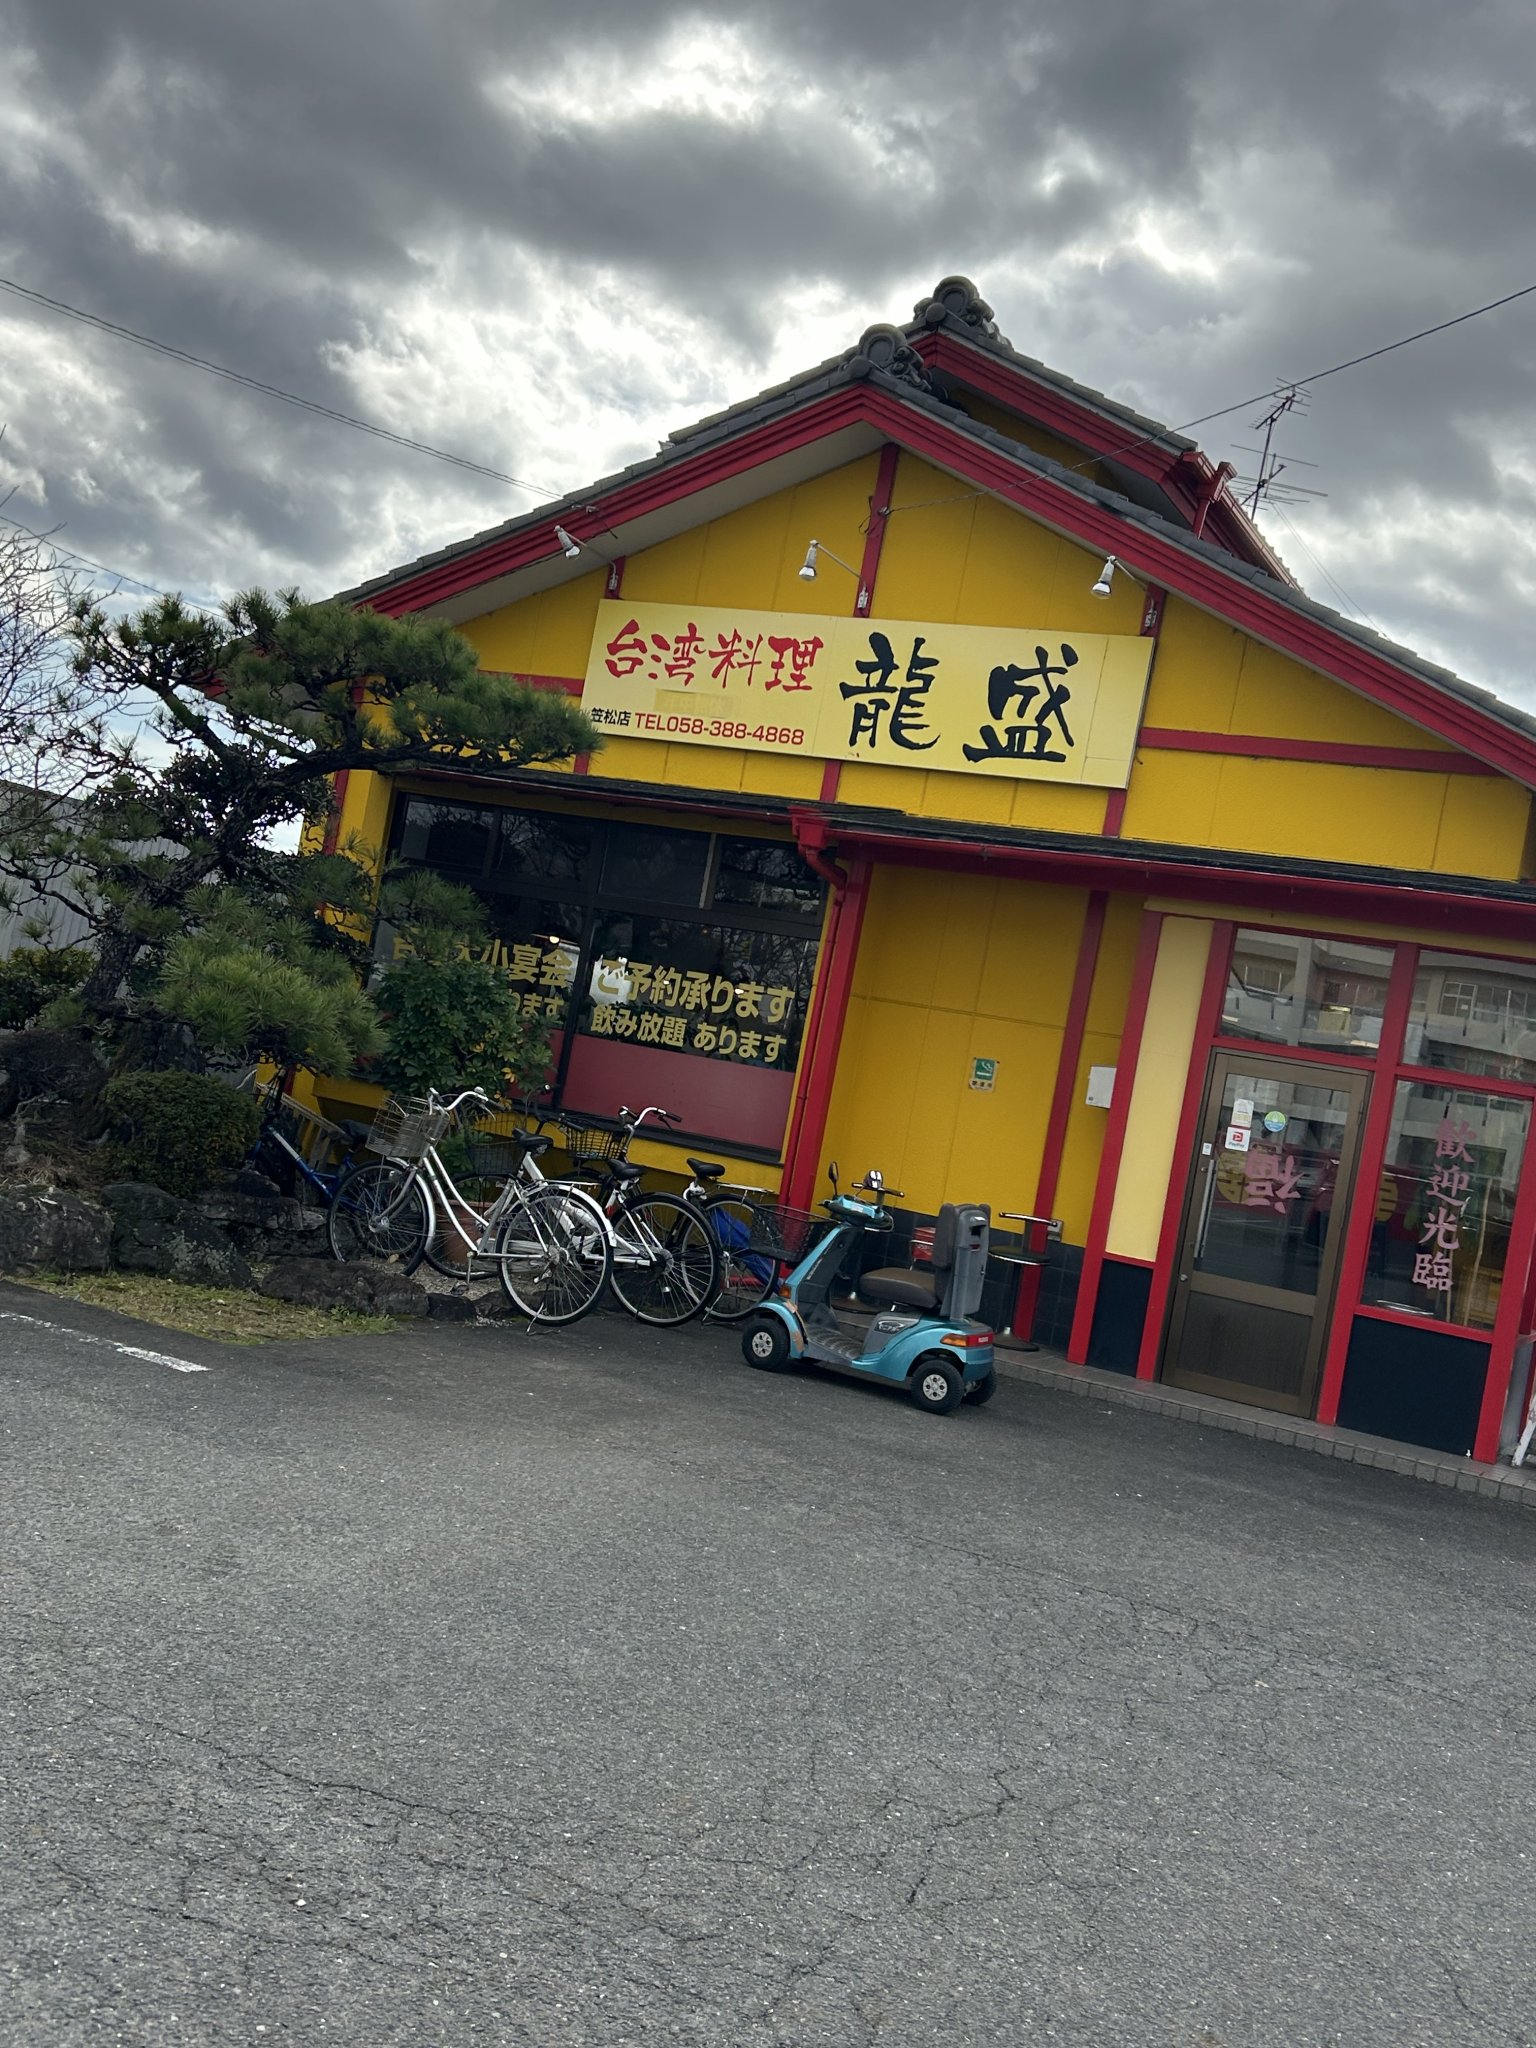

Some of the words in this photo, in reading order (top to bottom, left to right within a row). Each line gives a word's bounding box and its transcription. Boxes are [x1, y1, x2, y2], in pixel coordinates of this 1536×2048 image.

[591, 707, 632, 727] 笠松店
[604, 619, 824, 693] 台湾料理
[839, 632, 1079, 764] 龍盛
[590, 1004, 688, 1048] 飲み放題
[693, 1022, 788, 1063] あります
